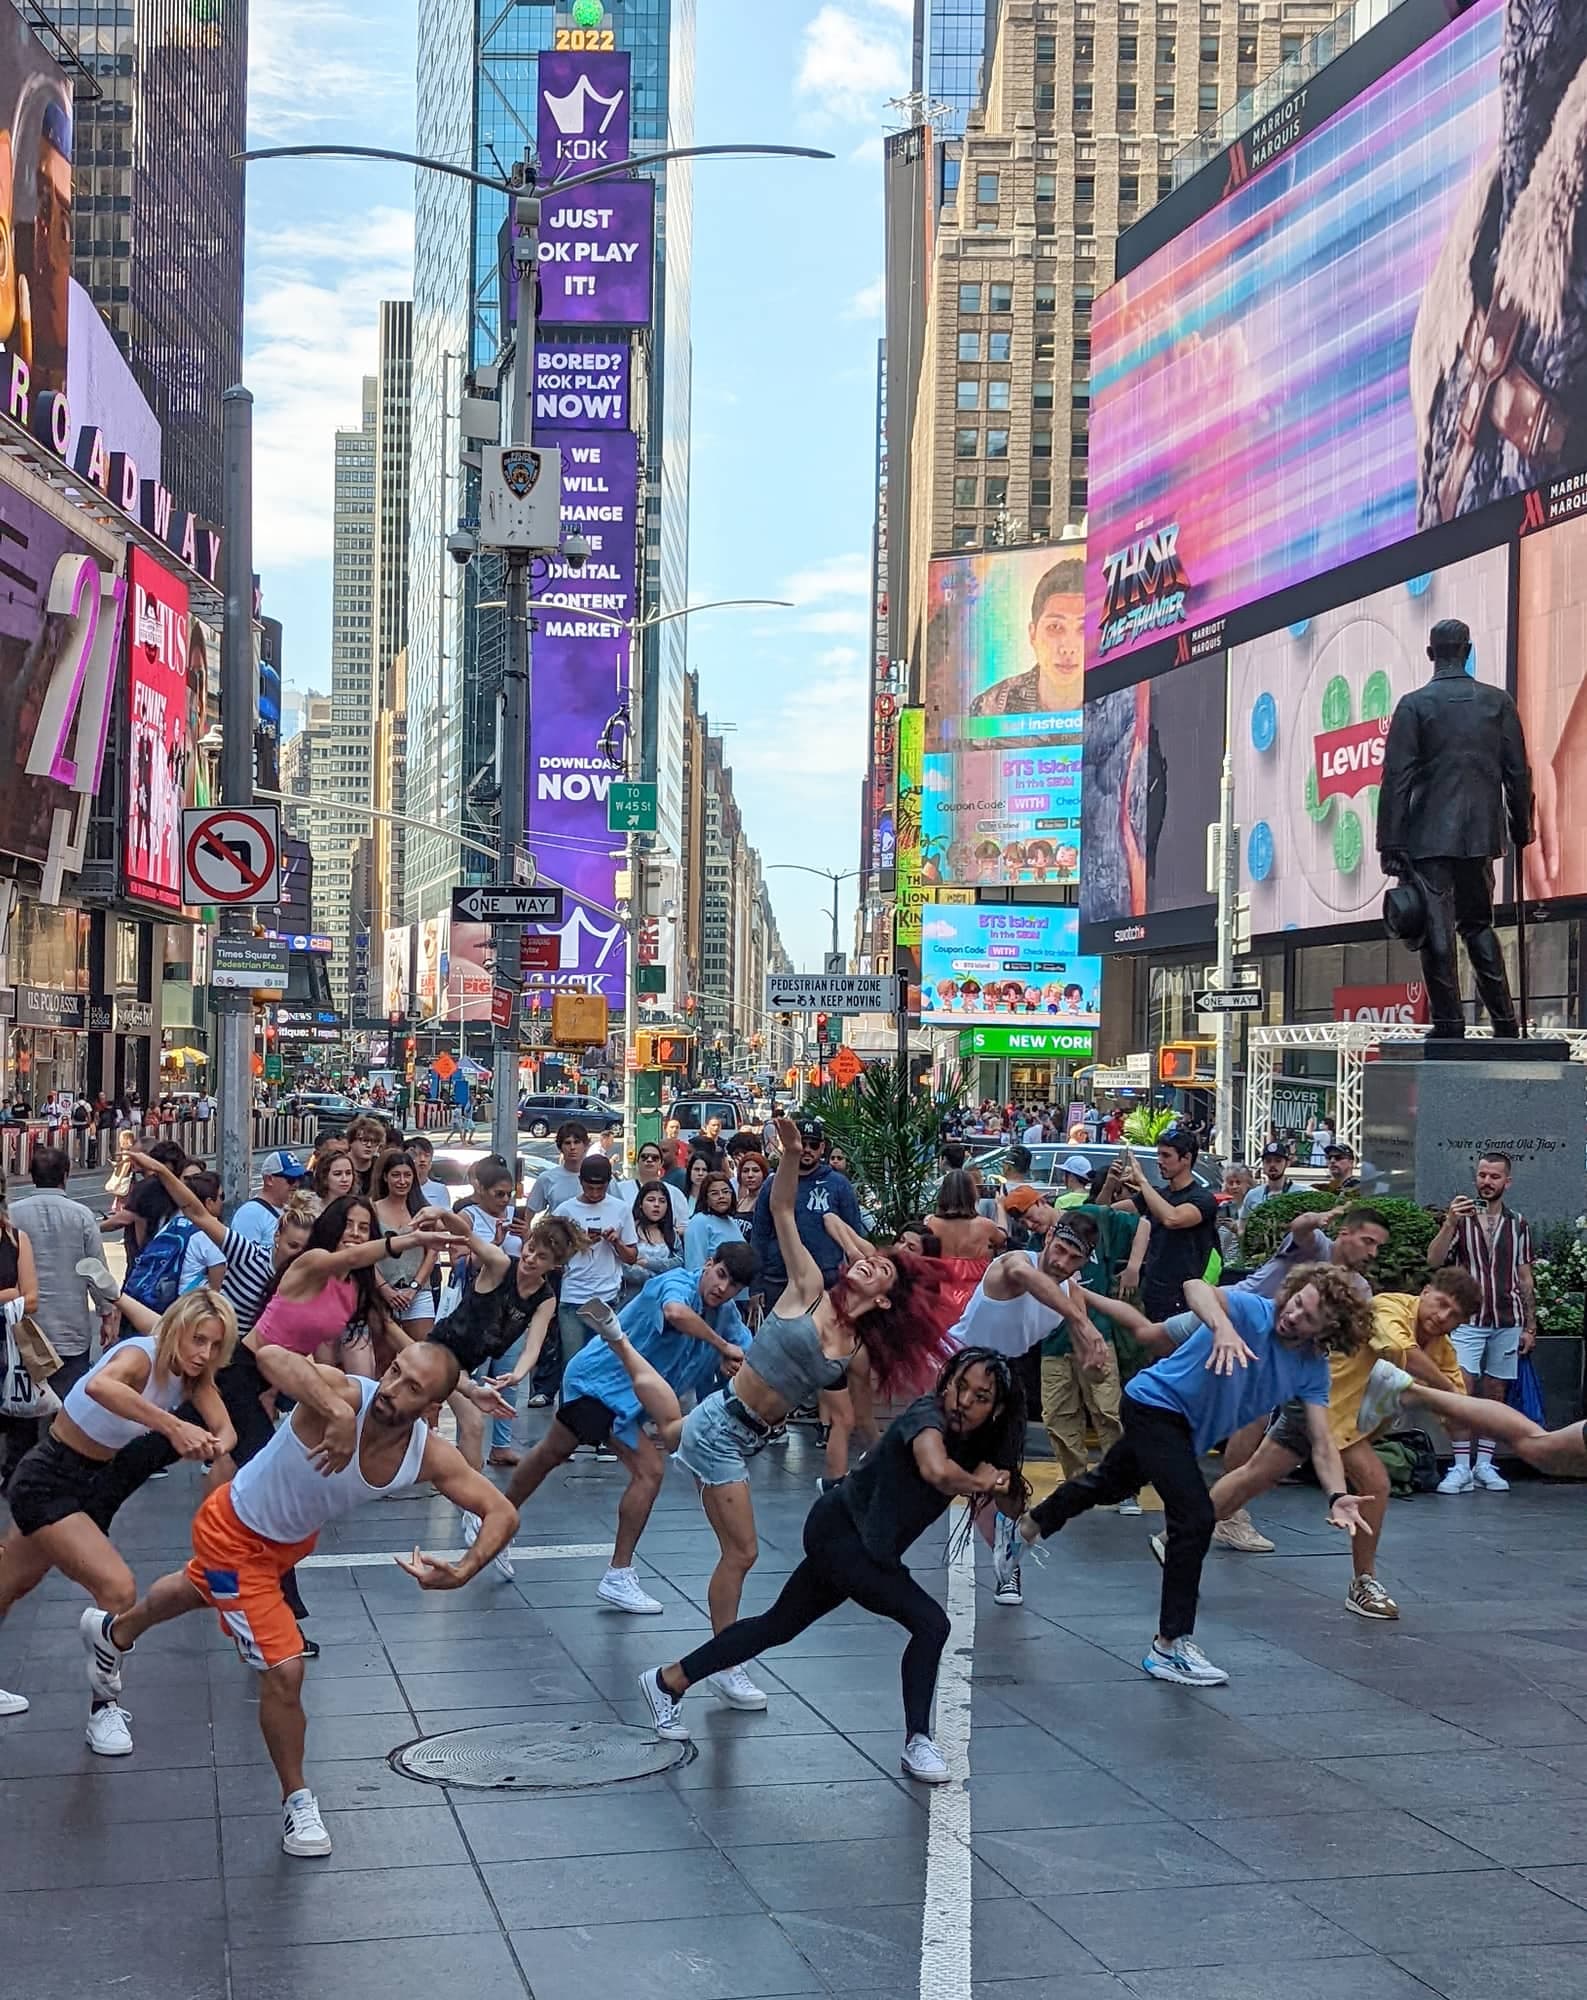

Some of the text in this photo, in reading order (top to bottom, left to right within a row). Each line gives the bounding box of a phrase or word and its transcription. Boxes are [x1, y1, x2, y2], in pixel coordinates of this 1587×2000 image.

[556, 30, 614, 50] 2022
[1252, 90, 1308, 146] MARRIOTT
[556, 140, 608, 159] KOK
[1251, 118, 1301, 169] MARQUIS
[550, 209, 613, 228] JUST
[538, 243, 639, 262] OK PLAY
[565, 276, 596, 296] IT!
[538, 353, 622, 370] BORED?
[538, 375, 621, 390] KOK PLAY
[537, 395, 622, 419] NOW!
[0, 342, 220, 581] ROADWAY
[571, 448, 600, 463] WE
[563, 477, 608, 492] WILL
[1550, 473, 1587, 498] MARRI
[1550, 493, 1587, 517] MARQU
[560, 506, 623, 522] HANGE
[549, 565, 620, 580] DIGITAL
[1100, 523, 1189, 620] THOR
[541, 593, 627, 610] CONTENT
[546, 621, 622, 638] MARKET
[1191, 619, 1226, 641] MARRIOTT
[1191, 636, 1222, 656] MARQUIS
[1029, 716, 1082, 730] instead
[1002, 760, 1033, 776] BTS
[627, 788, 639, 797] TO
[616, 802, 625, 811] W
[626, 801, 639, 811] 45
[936, 801, 975, 812] Coupon
[977, 799, 1006, 810] Code:
[1014, 797, 1046, 809] WITH
[907, 876, 920, 885] TH
[902, 890, 929, 906] LION
[469, 900, 549, 913] ONE WAY
[899, 910, 923, 928] KIN
[979, 914, 1049, 928] BTS Island
[217, 949, 277, 961] Times Square
[933, 945, 963, 954] Coupon
[965, 946, 986, 954] Code:
[992, 946, 1016, 956] WITH
[217, 960, 285, 970] Pedestrian Plaza
[464, 982, 491, 993] PIG
[771, 979, 881, 991] PEDESTRIAN FLOW ZONE
[28, 992, 40, 1010] U.S.
[41, 992, 59, 1013] POLO
[821, 995, 881, 1007] KEEP MOVING
[1203, 996, 1254, 1006] ONE WAY
[288, 1013, 312, 1021] NEWS
[1009, 1034, 1046, 1047] NEW
[1271, 1089, 1318, 1102] COVER
[1271, 1100, 1318, 1130] ADWAY'S
[1475, 1140, 1481, 1149] a
[1484, 1138, 1514, 1150] Grand
[1517, 1138, 1534, 1150] Old
[1534, 1137, 1557, 1151] Flag
[806, 1186, 830, 1212] NY
